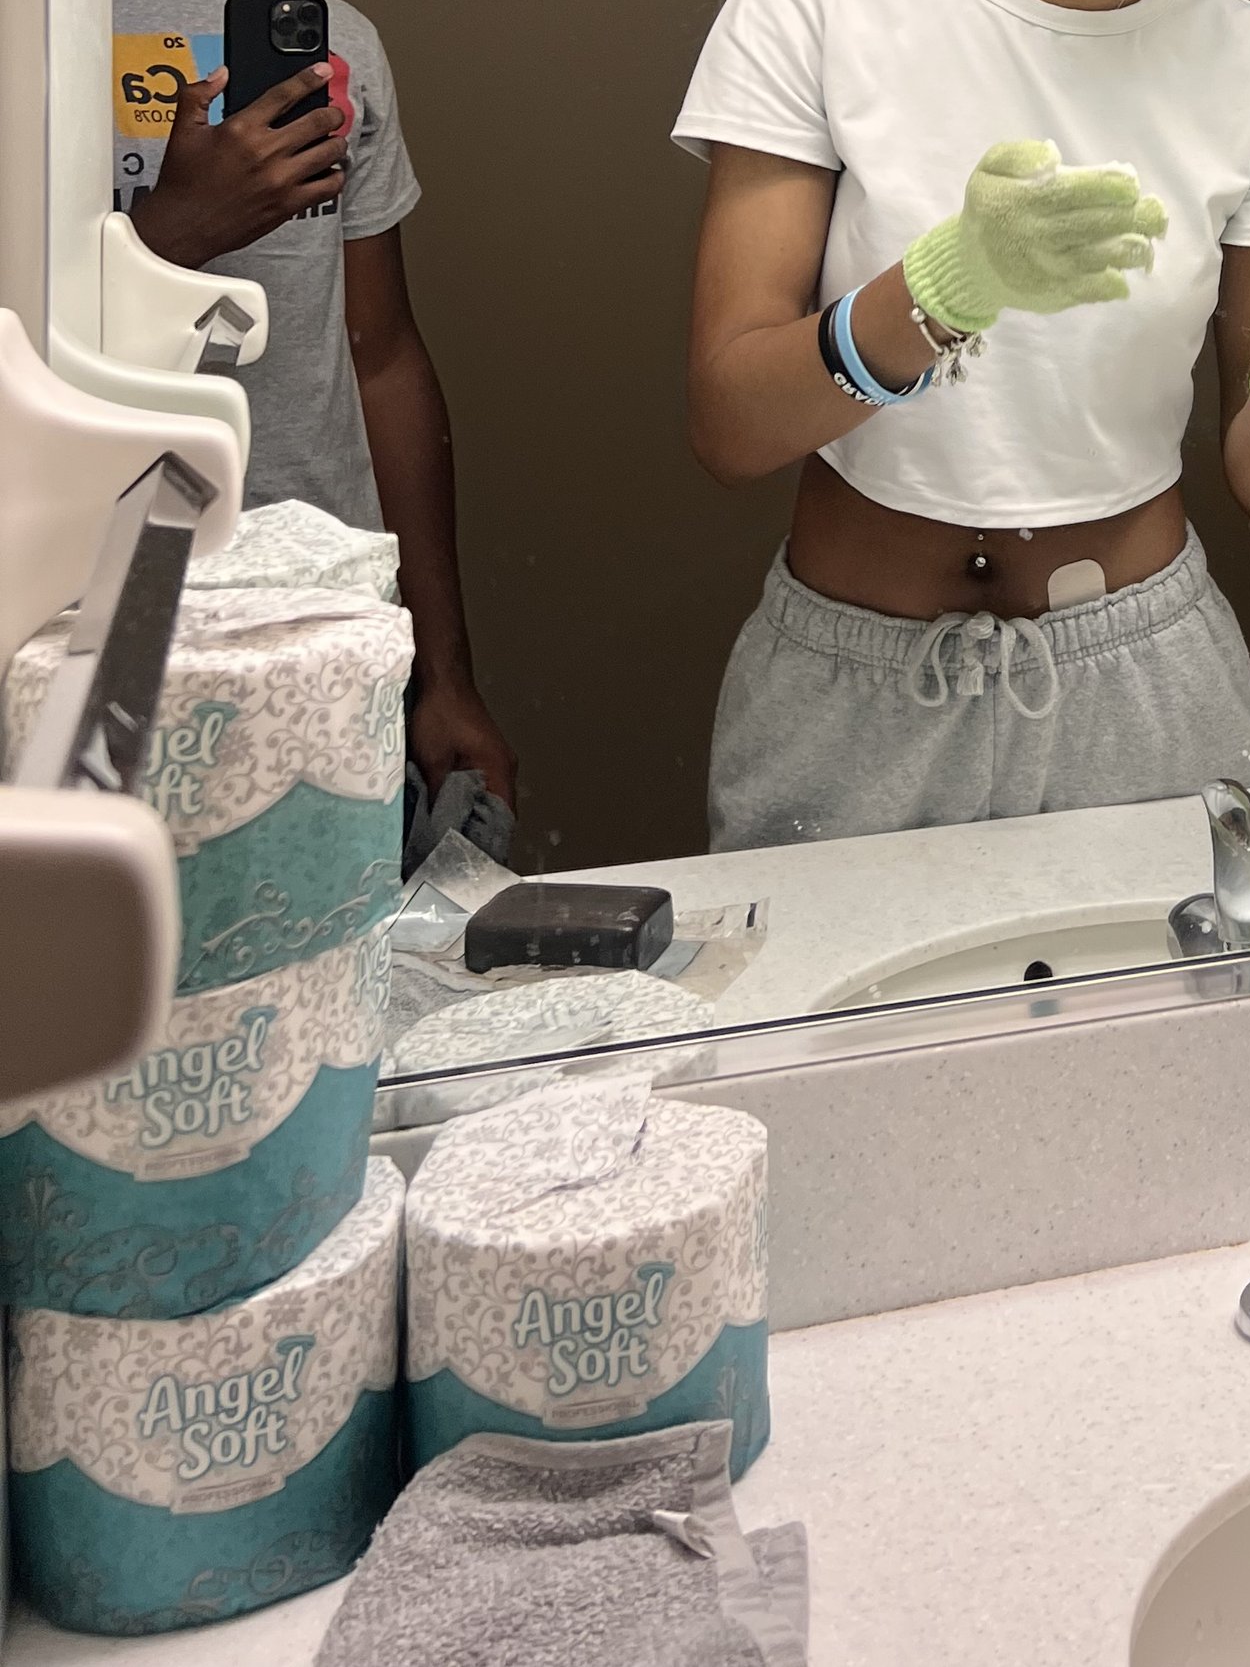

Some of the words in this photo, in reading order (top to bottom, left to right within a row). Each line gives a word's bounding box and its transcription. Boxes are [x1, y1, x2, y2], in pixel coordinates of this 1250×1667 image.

[107, 1022, 266, 1102] Angel
[140, 1071, 251, 1149] Soft
[513, 1271, 666, 1347] Angel
[140, 1346, 304, 1438] Angel
[549, 1331, 650, 1396] Soft
[177, 1405, 288, 1480] Soft
